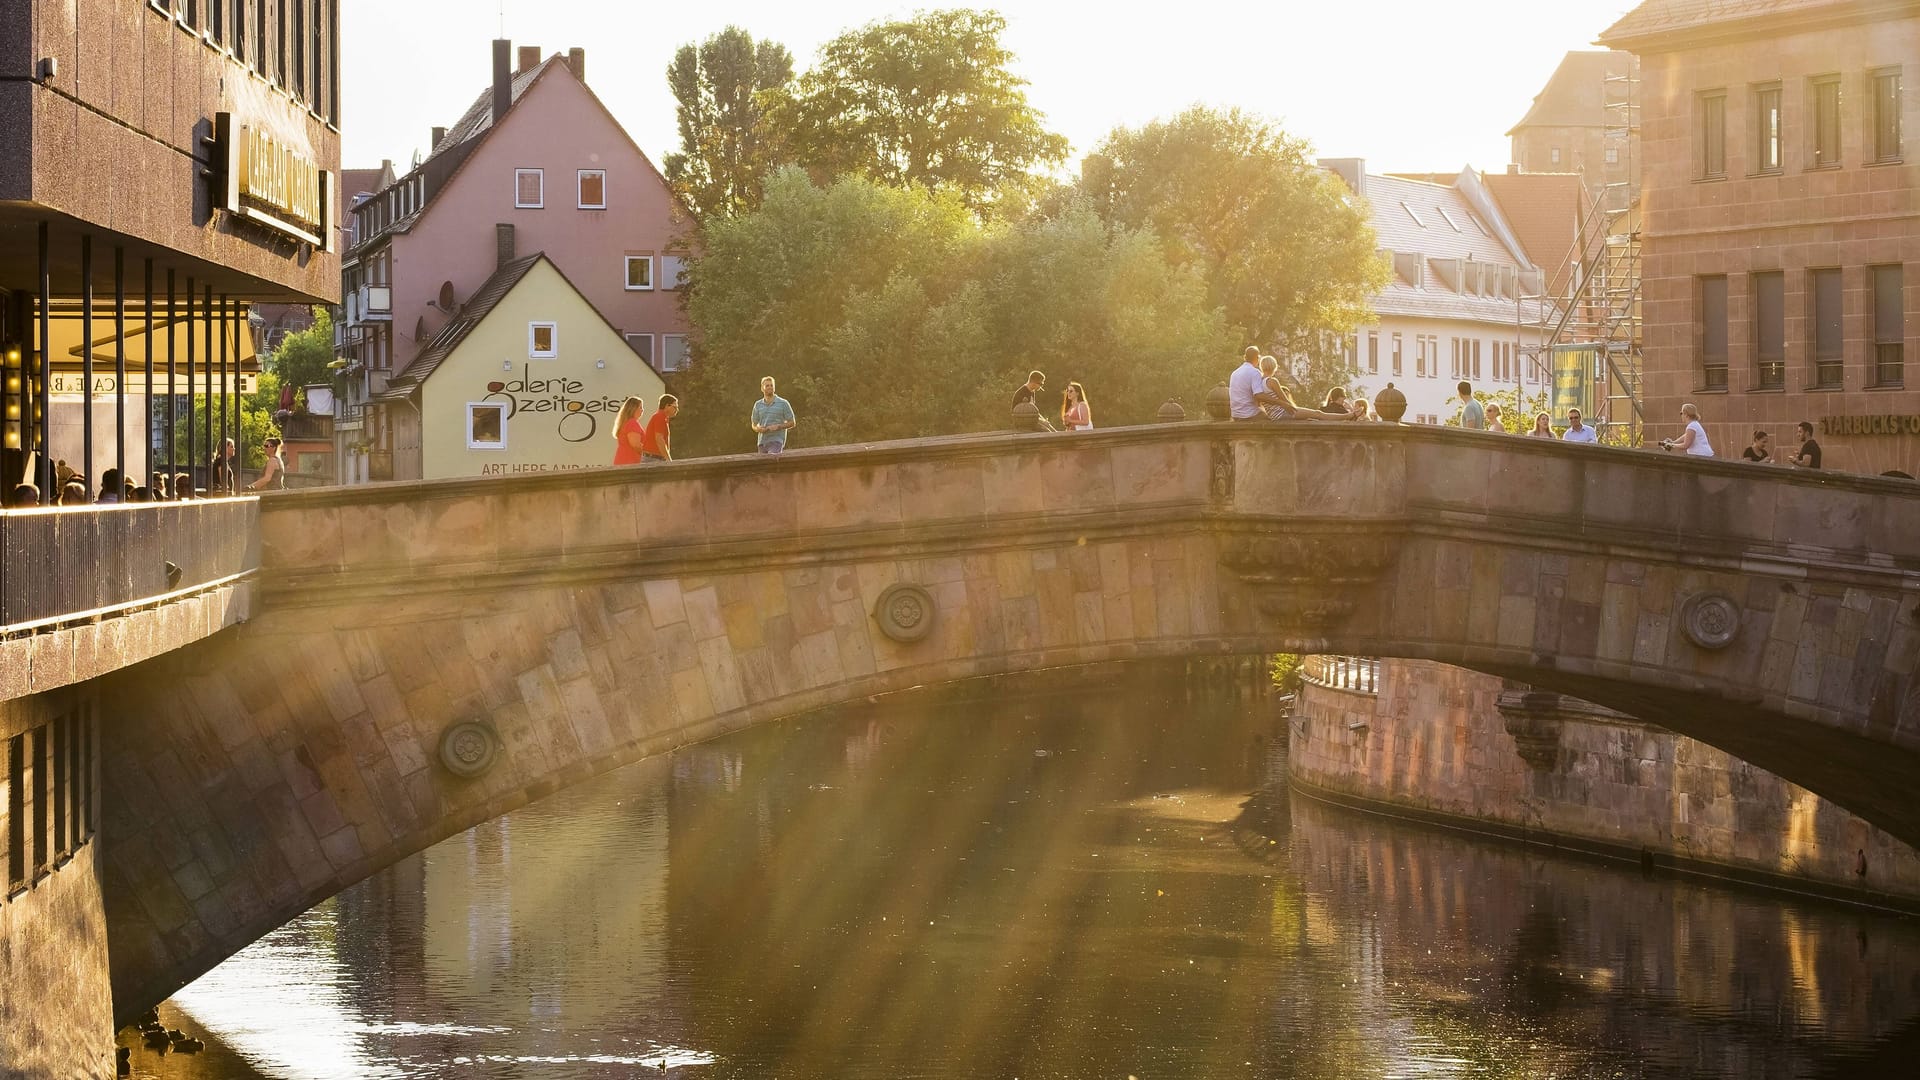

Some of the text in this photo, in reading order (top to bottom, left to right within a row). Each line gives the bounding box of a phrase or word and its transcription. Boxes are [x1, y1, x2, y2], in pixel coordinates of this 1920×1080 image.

[482, 363, 584, 420] galerie
[518, 396, 628, 442] zeitgeis
[1820, 415, 1898, 434] STARBUCKS
[482, 464, 508, 475] ART
